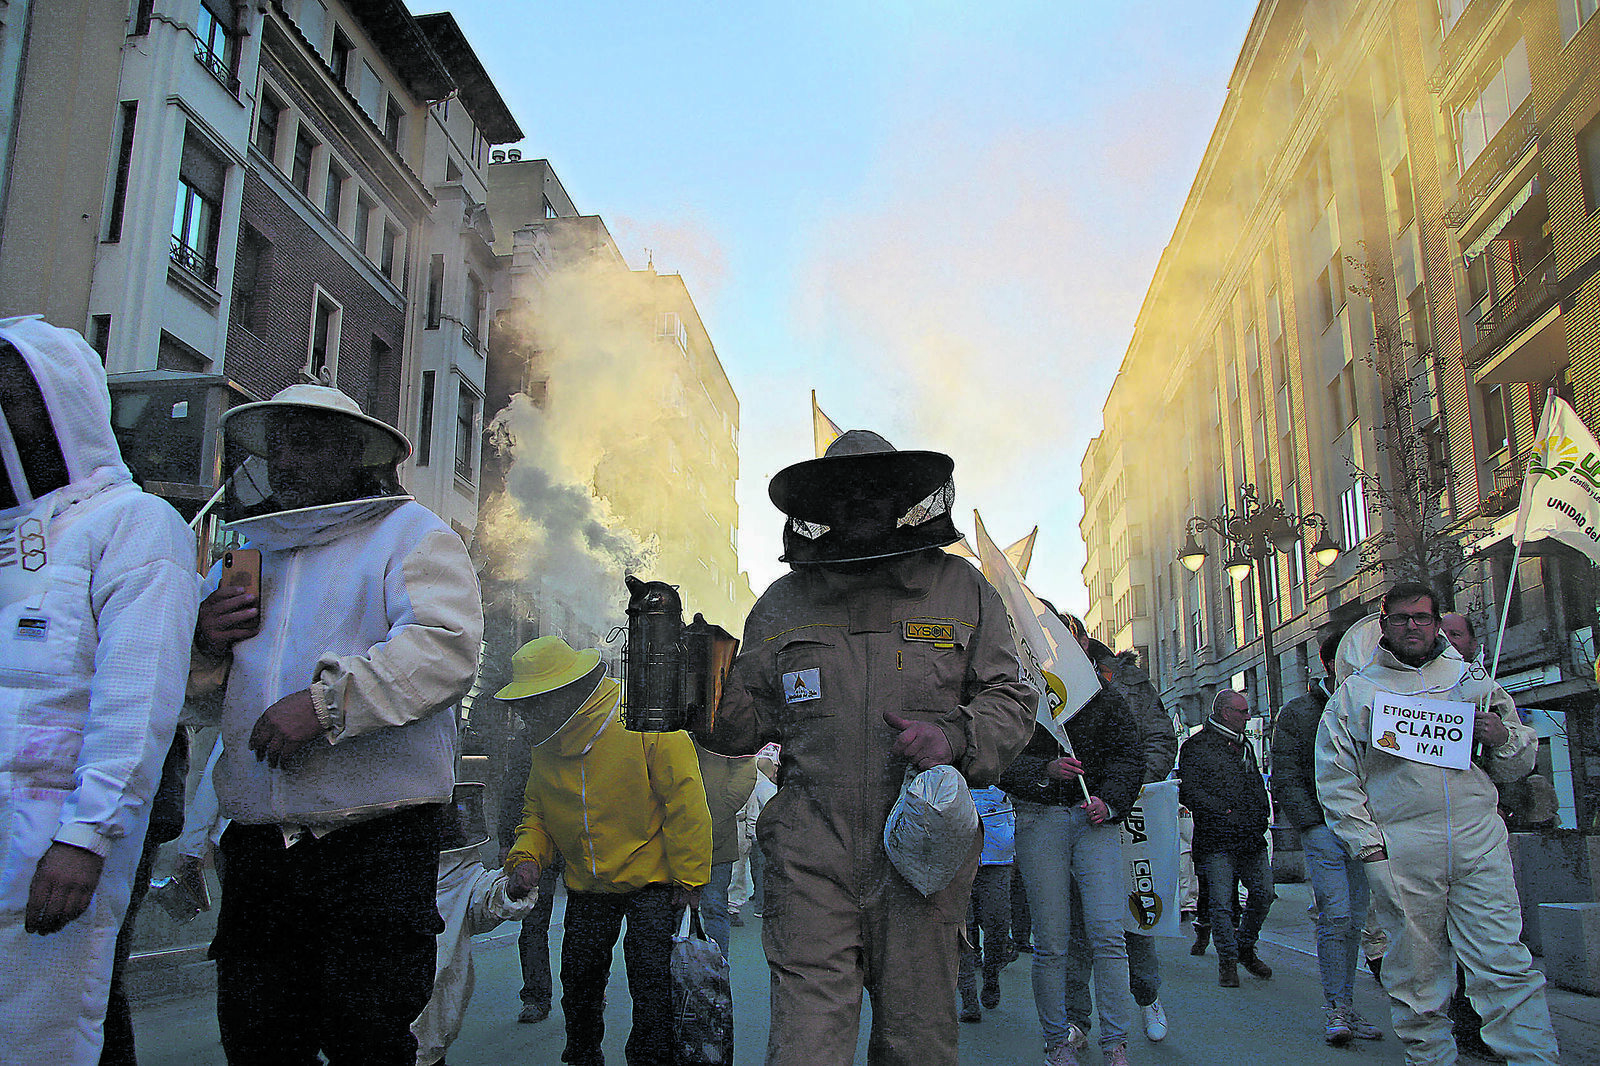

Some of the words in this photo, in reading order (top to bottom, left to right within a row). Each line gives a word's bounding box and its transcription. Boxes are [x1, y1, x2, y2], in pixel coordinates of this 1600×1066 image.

[1547, 497, 1586, 527] UNIDAD
[908, 625, 952, 638] LYSON
[1383, 705, 1464, 725] ETIQUETADO
[1396, 721, 1463, 742] CLARO
